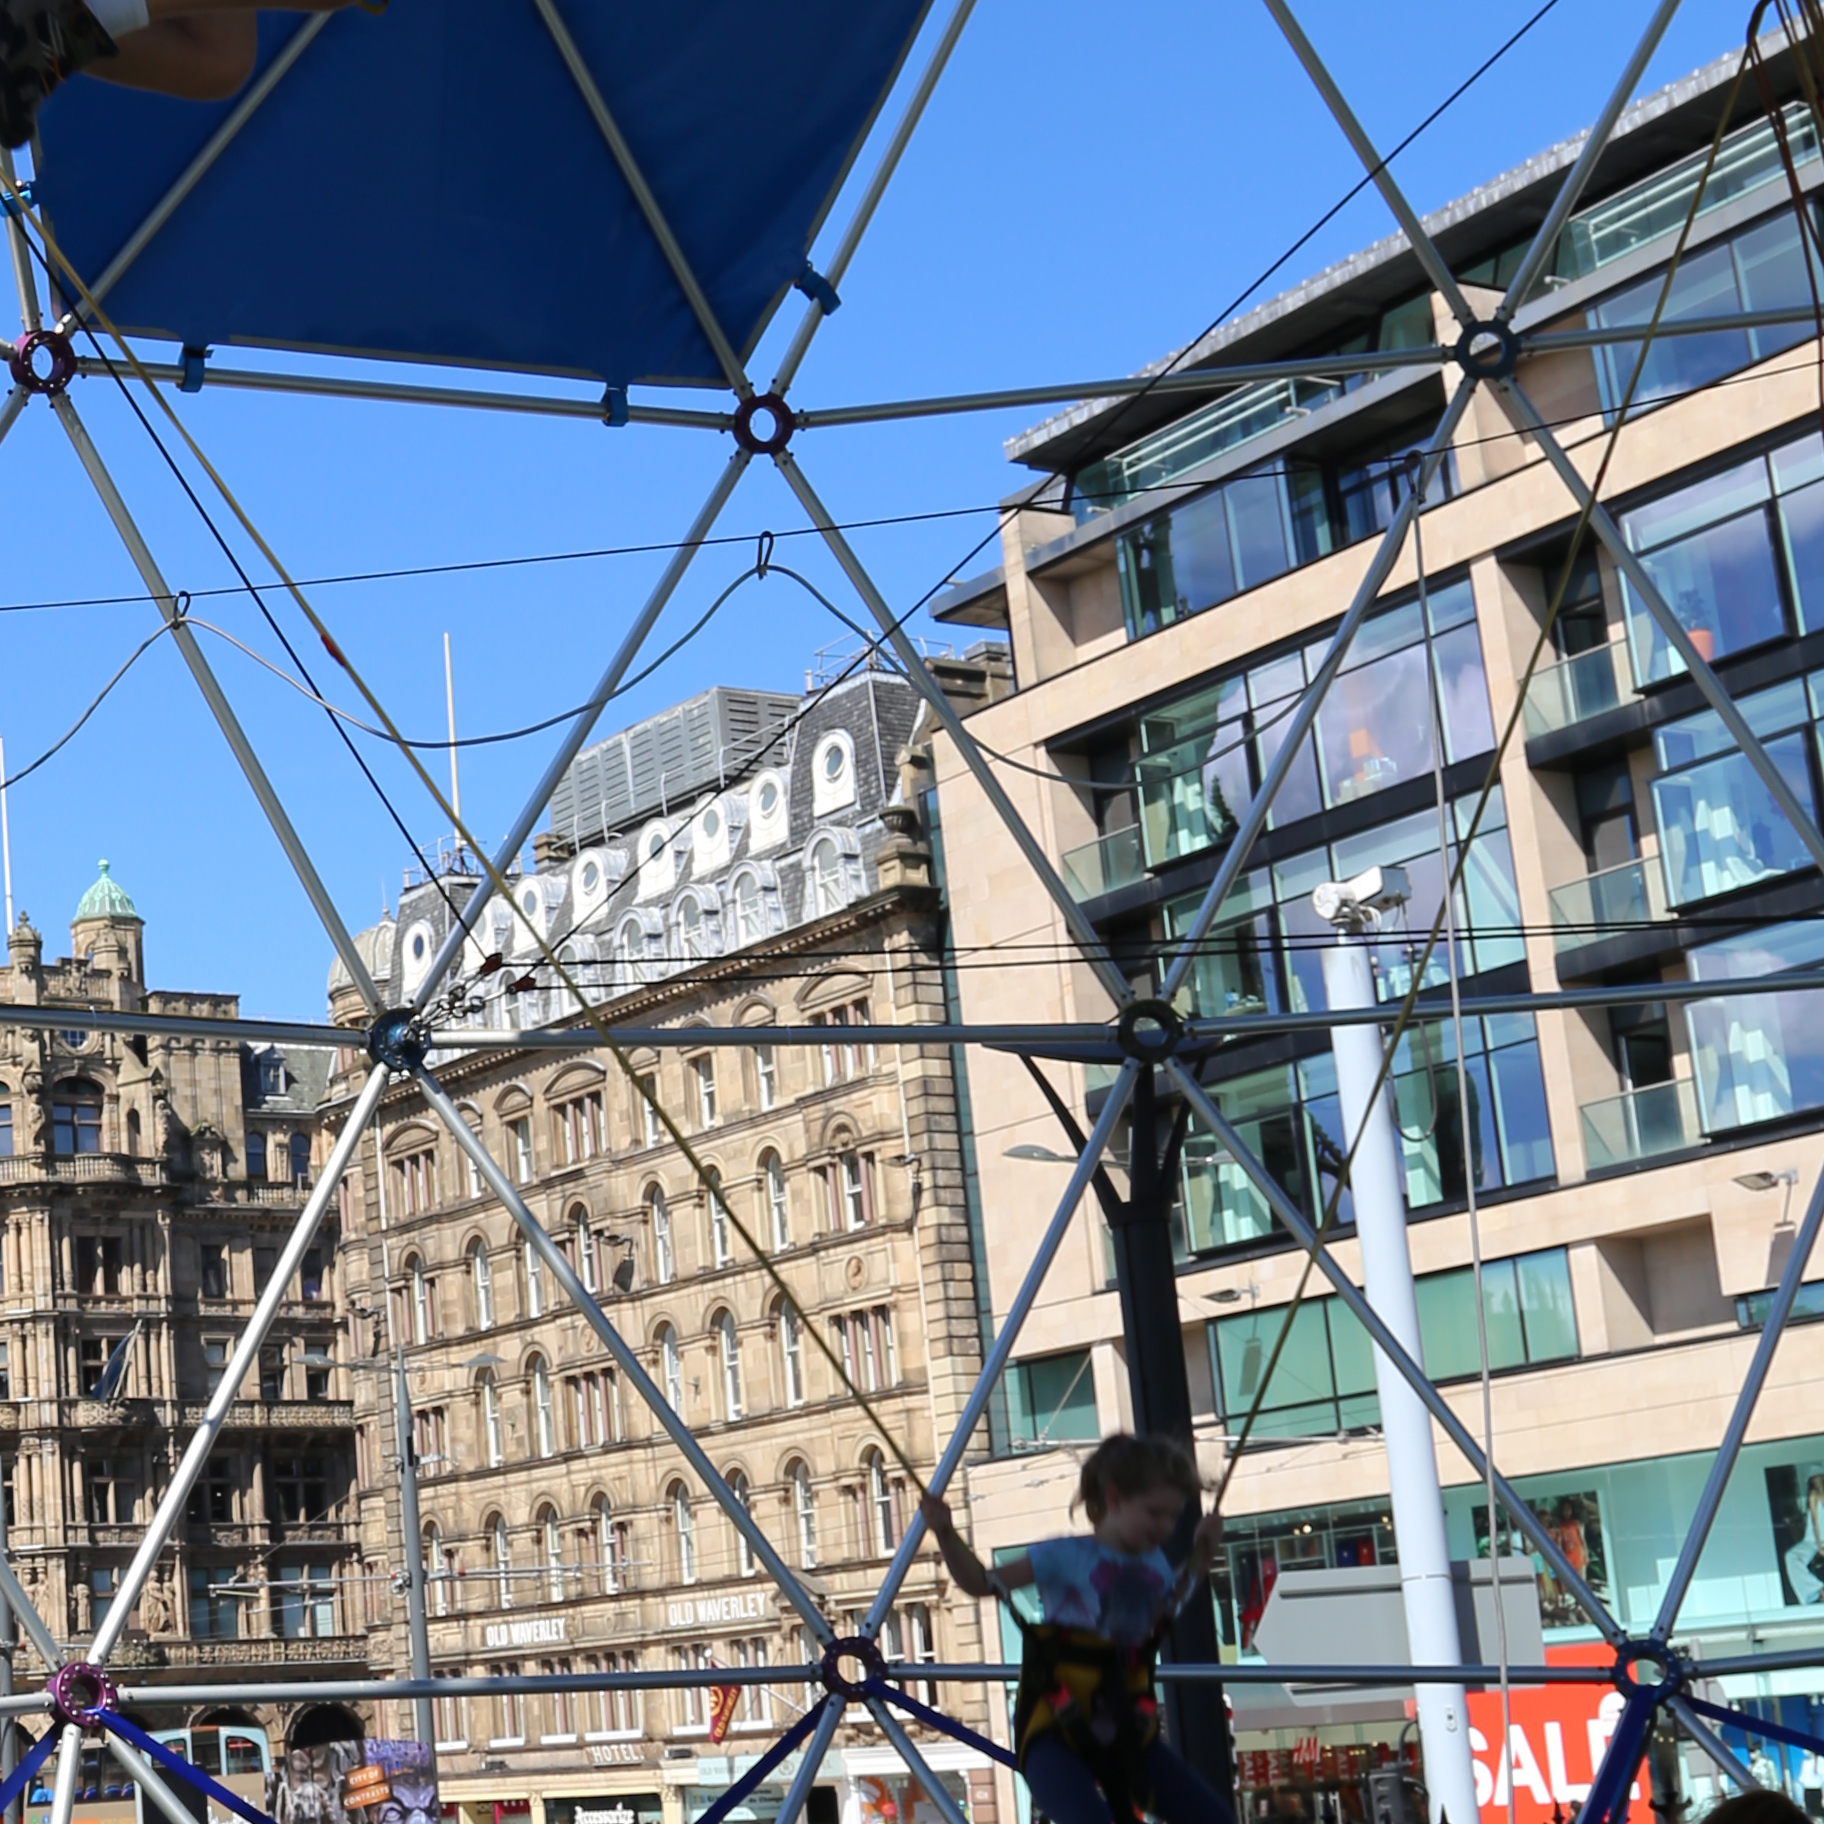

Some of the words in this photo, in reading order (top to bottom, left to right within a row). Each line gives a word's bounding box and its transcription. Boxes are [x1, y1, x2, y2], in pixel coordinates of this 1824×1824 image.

[669, 1601, 694, 1626] OLD
[696, 1592, 766, 1622] WAVERLEY
[486, 1624, 508, 1647] OLD
[509, 1617, 566, 1645] WAVERLEY
[343, 1786, 390, 1806] CONTRASTS
